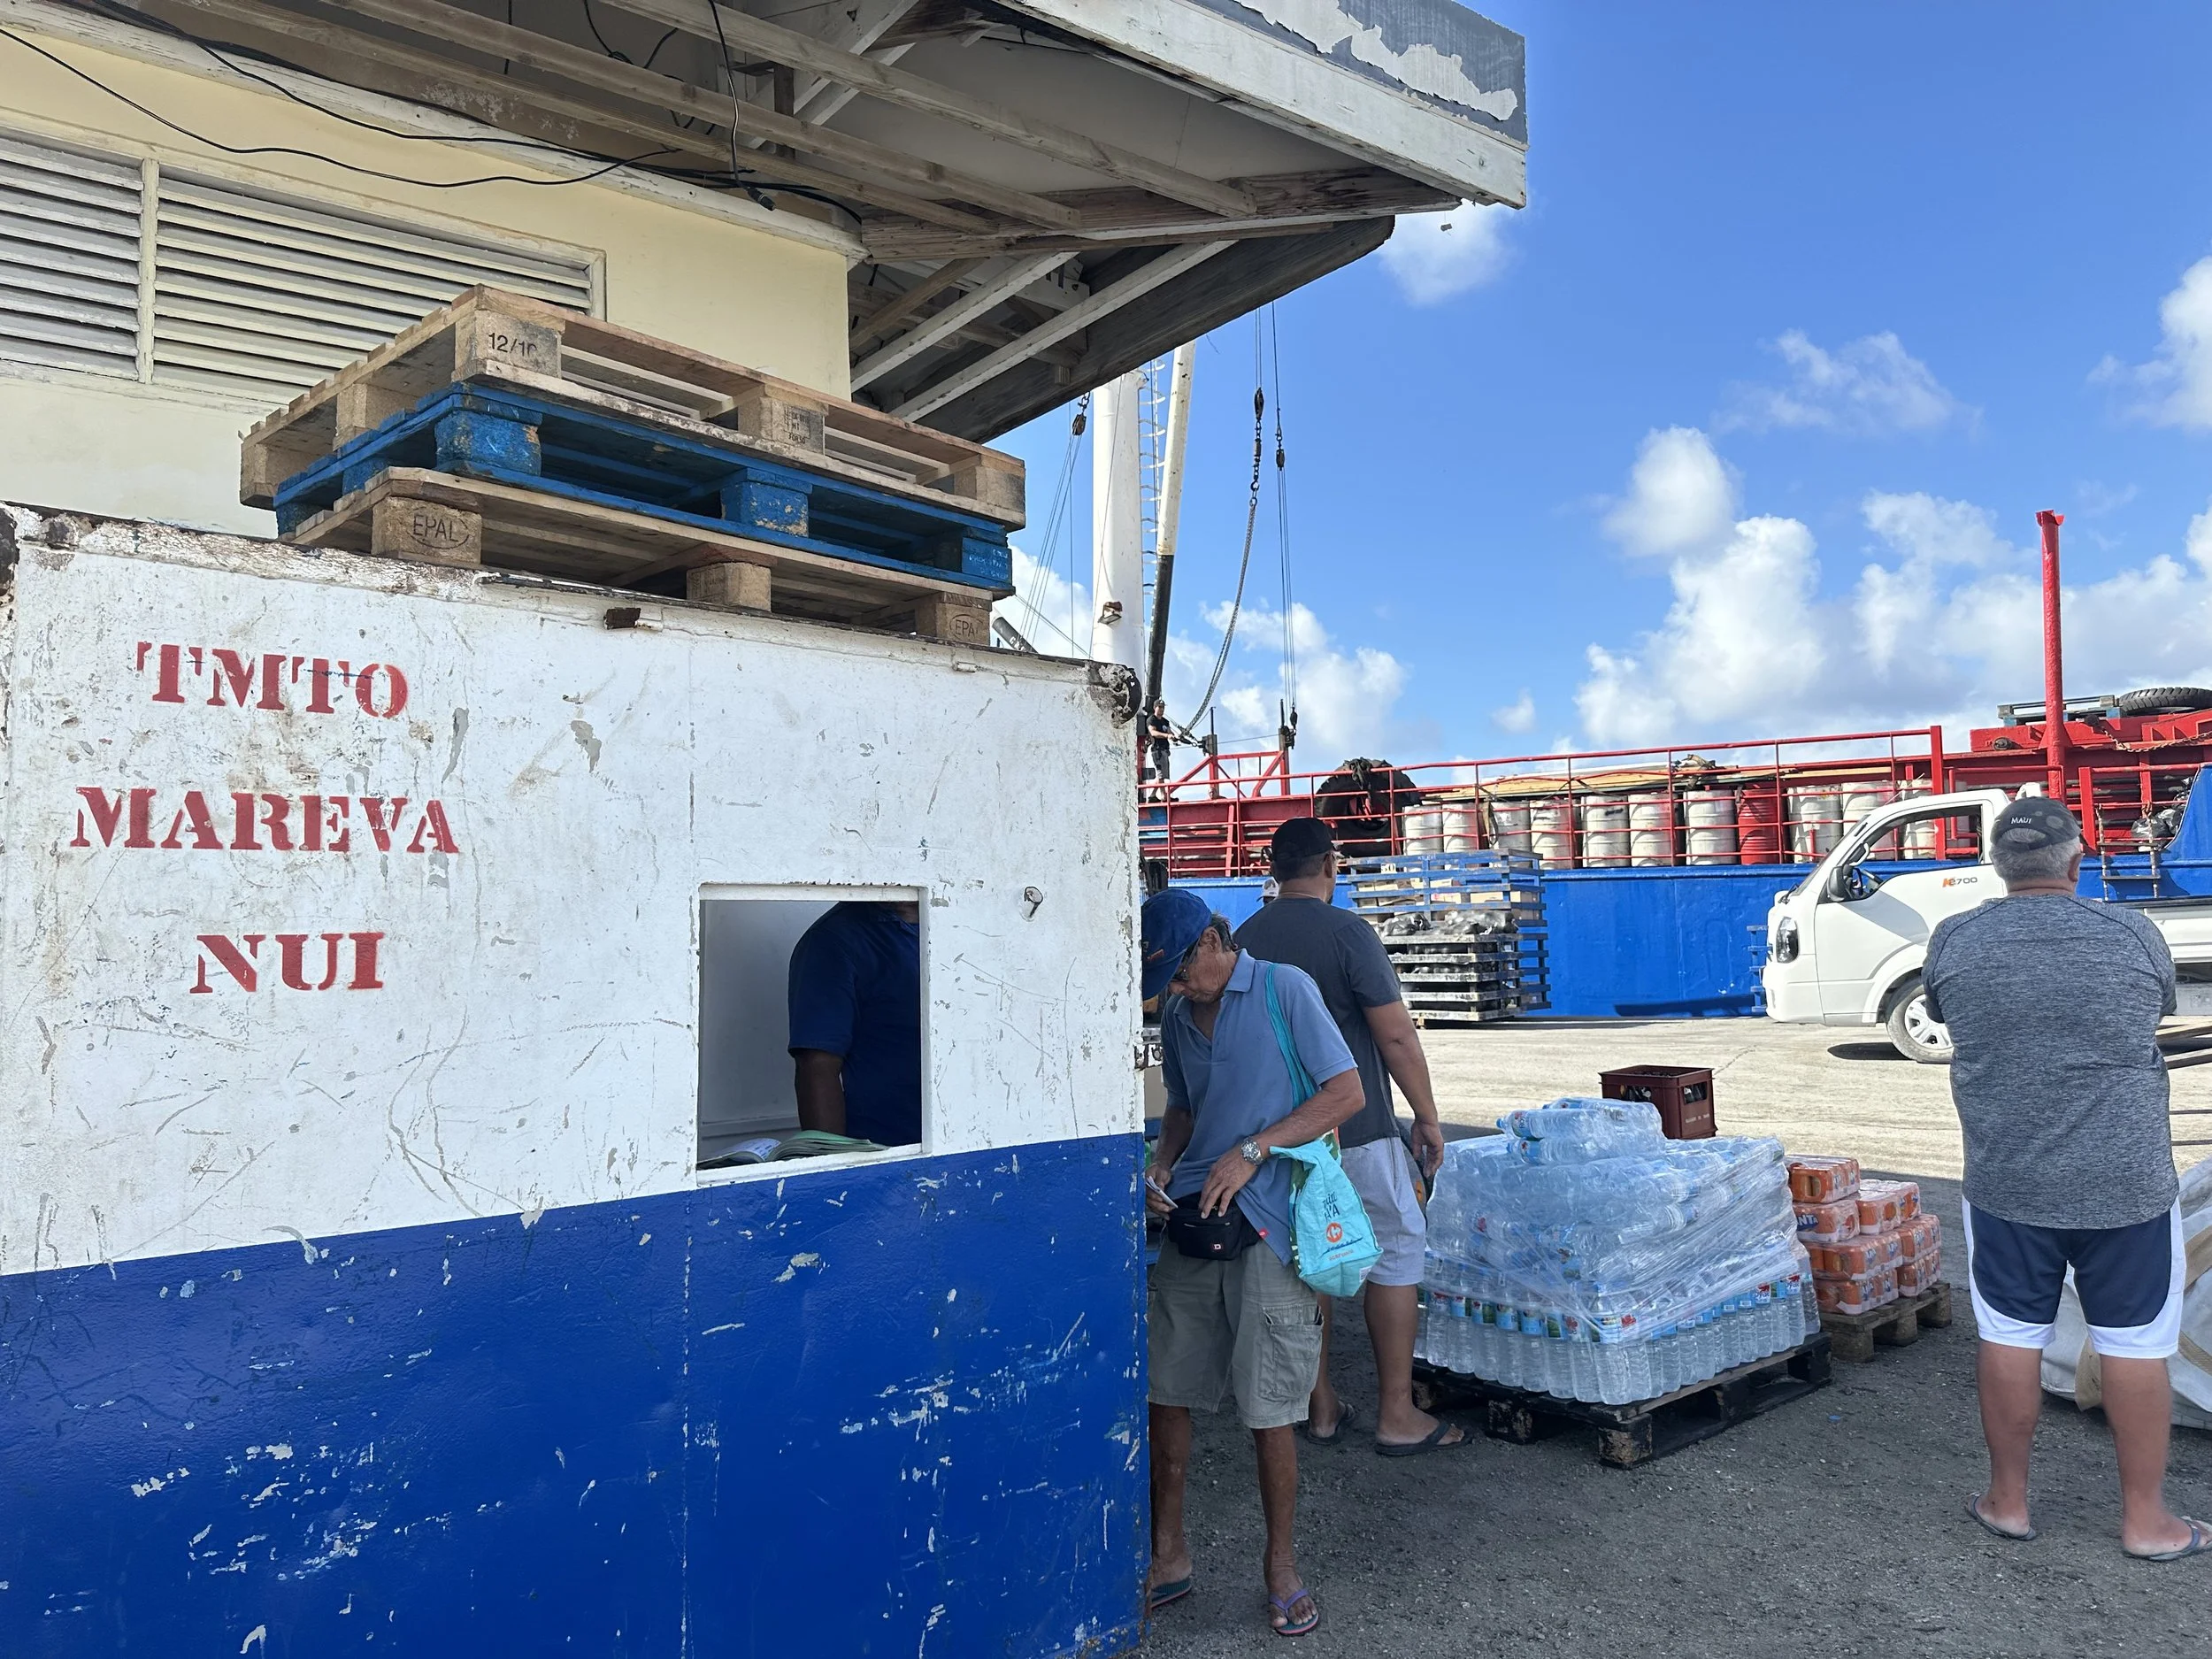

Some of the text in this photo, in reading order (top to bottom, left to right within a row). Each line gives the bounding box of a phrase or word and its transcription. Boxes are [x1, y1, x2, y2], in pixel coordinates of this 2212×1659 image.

[412, 514, 459, 542] EPAL
[137, 641, 409, 718] TMTO
[70, 786, 458, 854] MAREVA
[2010, 816, 2032, 825] MAUI
[1941, 876, 1978, 887] K2700
[189, 932, 384, 994] NUI
